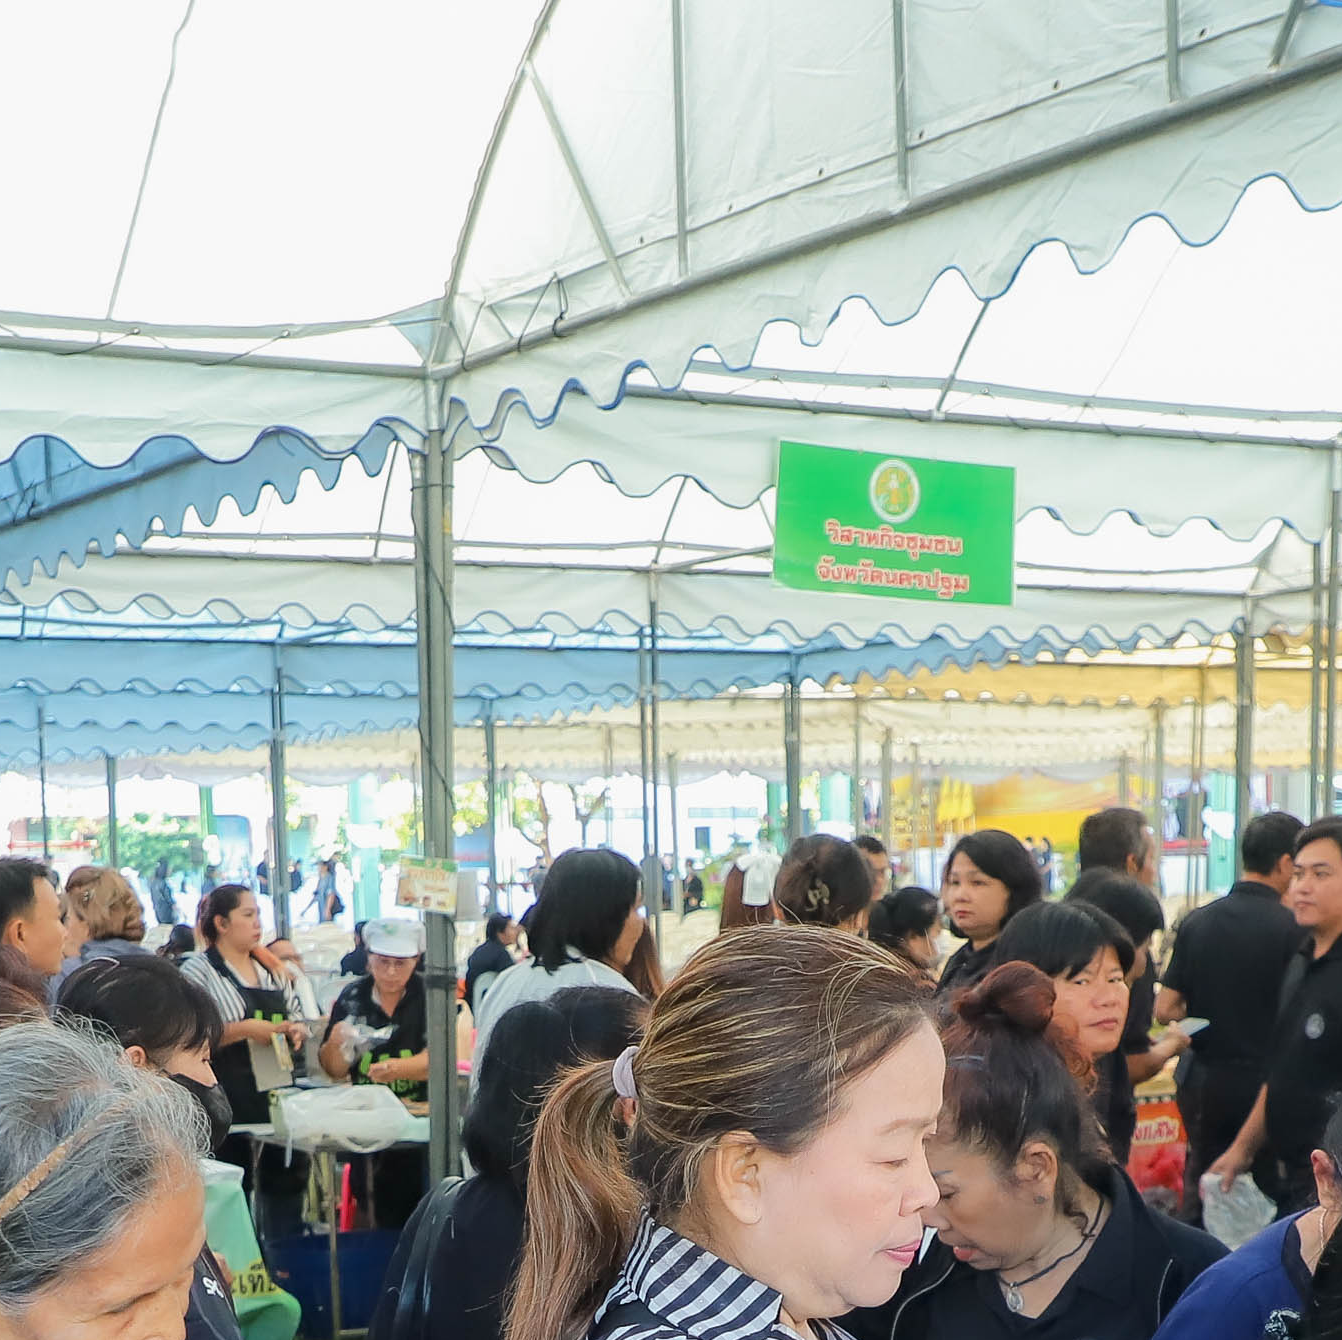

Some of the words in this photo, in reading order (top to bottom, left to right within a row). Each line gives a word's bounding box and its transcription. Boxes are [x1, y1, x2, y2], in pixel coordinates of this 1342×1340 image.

[825, 519, 963, 559] วิสาหกิจชุมชน
[817, 556, 970, 598] จังหวัดนครปฐม
